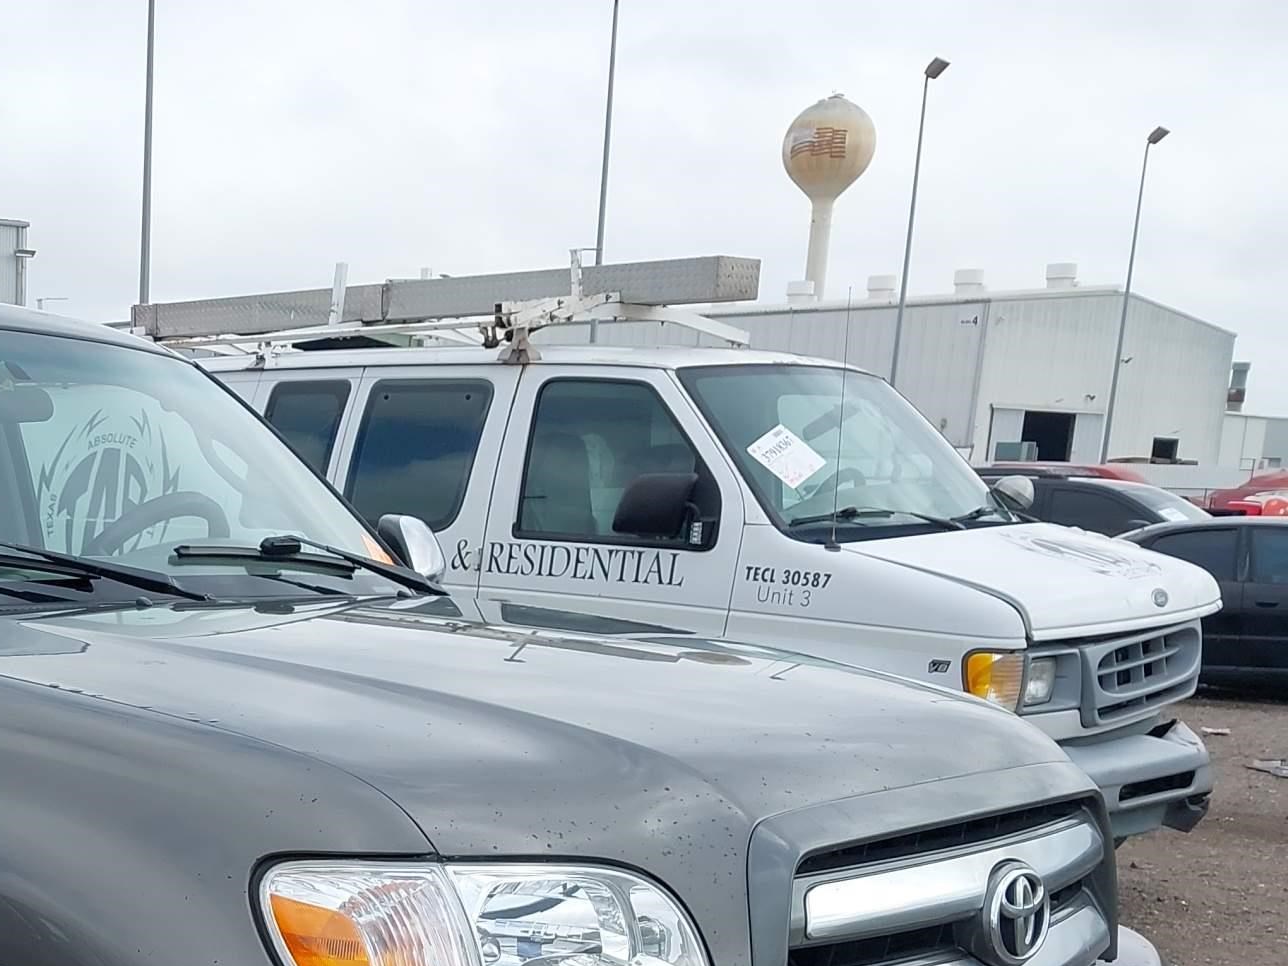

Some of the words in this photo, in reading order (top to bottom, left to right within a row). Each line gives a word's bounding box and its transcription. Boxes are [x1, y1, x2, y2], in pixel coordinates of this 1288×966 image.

[87, 432, 138, 449] ABSOLUTE
[46, 494, 58, 538] TEXAS
[450, 538, 473, 571] &
[485, 541, 685, 587] RESIDENTIAL
[745, 565, 776, 584] TECL
[781, 569, 832, 589] 30587
[757, 585, 793, 606] Unit
[799, 589, 811, 608] 3
